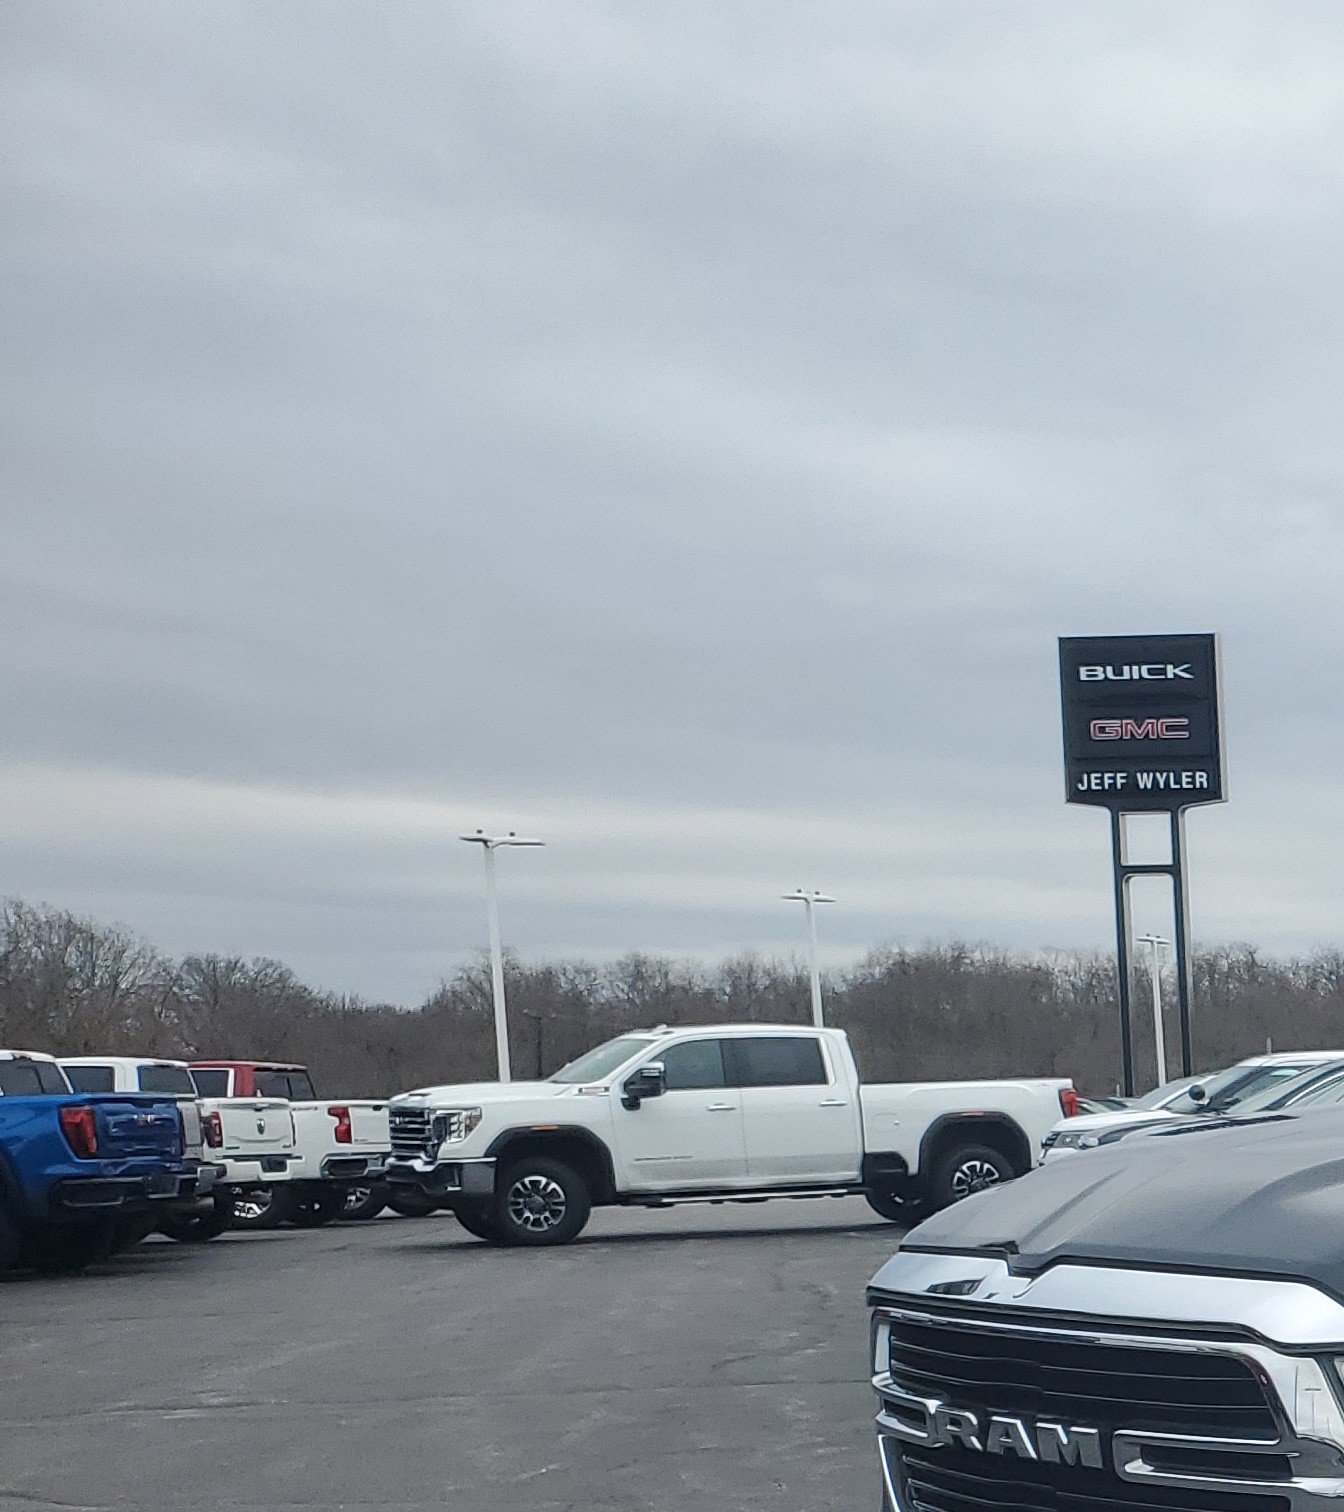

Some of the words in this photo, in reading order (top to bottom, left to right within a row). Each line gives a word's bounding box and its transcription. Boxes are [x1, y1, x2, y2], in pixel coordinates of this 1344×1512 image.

[1078, 663, 1194, 681] BUICK
[1090, 717, 1190, 741] GMC
[1077, 772, 1128, 791] JEFF
[1136, 770, 1208, 790] WYLER
[935, 1408, 1103, 1469] RAM
